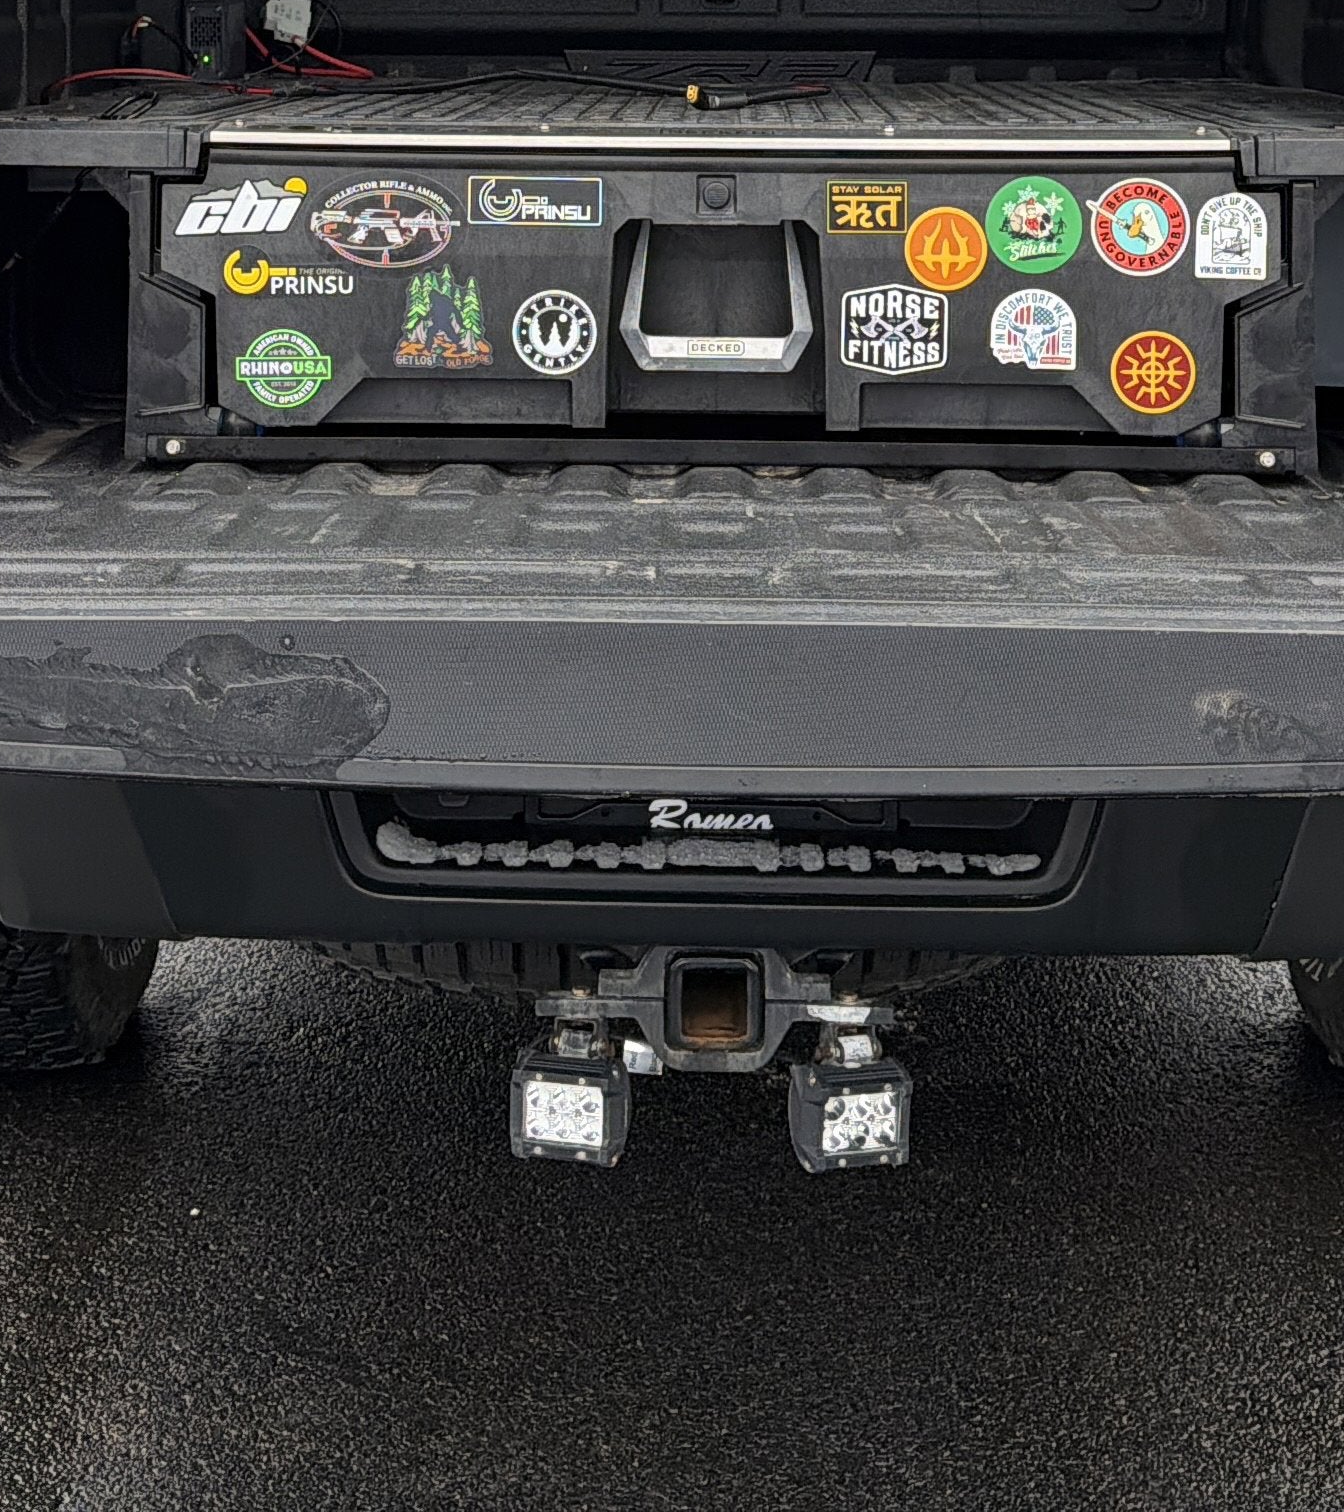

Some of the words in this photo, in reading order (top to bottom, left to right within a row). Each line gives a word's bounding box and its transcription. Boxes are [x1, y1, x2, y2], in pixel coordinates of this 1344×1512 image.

[324, 180, 379, 209] COLLECTOR
[379, 180, 407, 190] RIFLE
[415, 185, 444, 206] AMMO
[831, 185, 860, 194] STAY
[863, 185, 903, 194] SOLAR
[1105, 185, 1168, 210] BECOME
[521, 205, 591, 221] PRINSU
[1208, 197, 1228, 213] GIVE
[1229, 196, 1242, 206] UP
[1242, 199, 1259, 217] THE
[1252, 216, 1263, 238] SHIP
[1098, 211, 1183, 268] UNGOVERNABLE
[298, 267, 314, 276] THE
[316, 267, 349, 276] ORIGIN
[1225, 266, 1252, 276] COFFEE
[270, 275, 354, 295] PRINSU
[522, 297, 588, 326] STRIKE
[850, 290, 940, 320] NORSE
[995, 292, 1053, 330] DISCOMFORT
[1053, 301, 1069, 321] WE
[253, 333, 290, 357] AMERICAN
[691, 343, 741, 353] DECKED
[994, 333, 1006, 345] IN
[1061, 322, 1073, 355] TRUST
[395, 355, 413, 366] GET
[415, 353, 437, 367] LOST
[446, 358, 462, 368] OLD
[523, 344, 586, 368] GENTLY
[848, 339, 941, 369] FITNESS
[252, 380, 277, 403] FAMILY
[278, 380, 315, 404] OPERATED
[648, 798, 775, 830] Romeo
